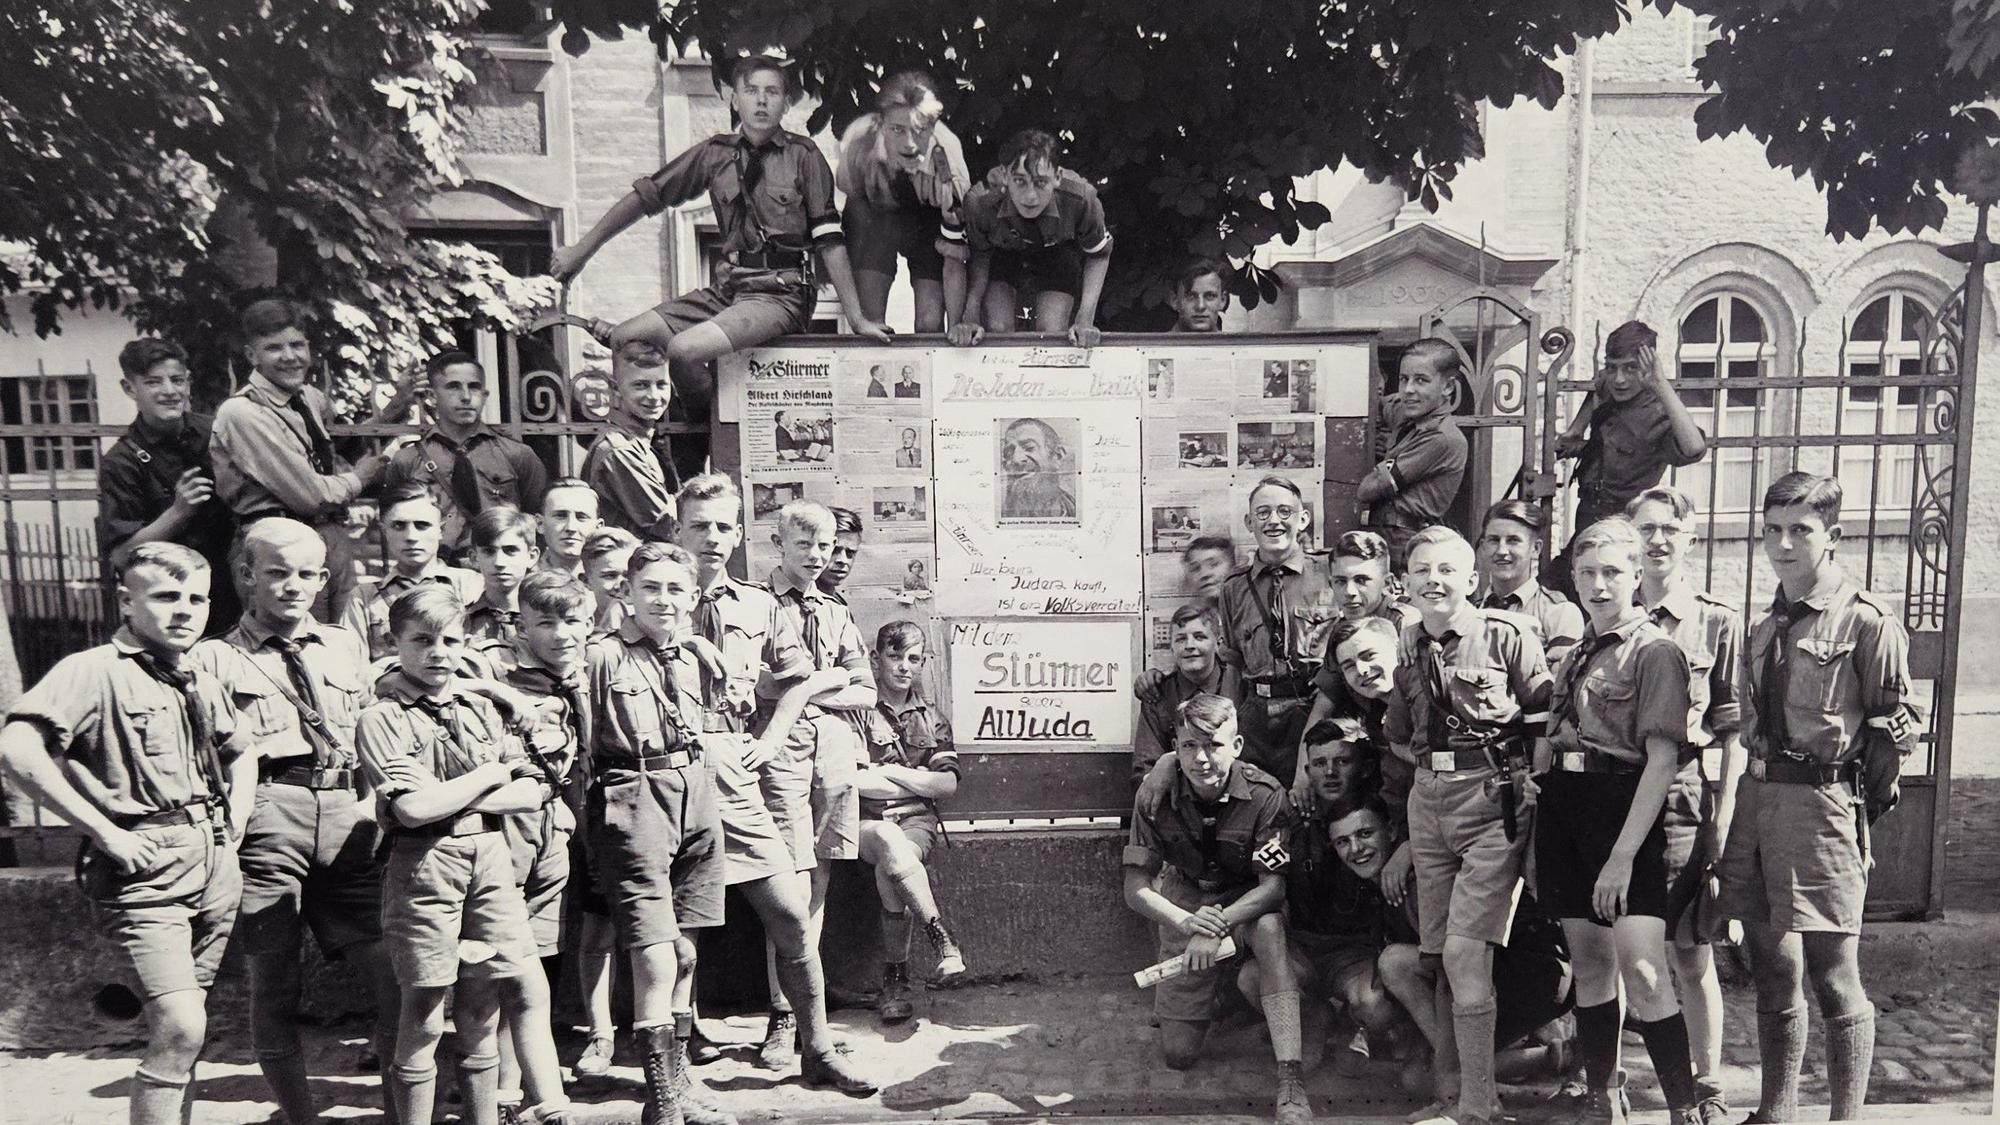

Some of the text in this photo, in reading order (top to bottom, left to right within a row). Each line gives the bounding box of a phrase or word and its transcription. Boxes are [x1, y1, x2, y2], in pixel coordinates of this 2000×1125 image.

[773, 359, 830, 377] Stürmer
[747, 389, 833, 400] Albert Hirschland
[947, 373, 983, 397] Die
[984, 373, 1044, 397] Juden
[1010, 575, 1067, 591] Juden
[950, 623, 981, 647] Mit
[978, 651, 1119, 688] Stürmer
